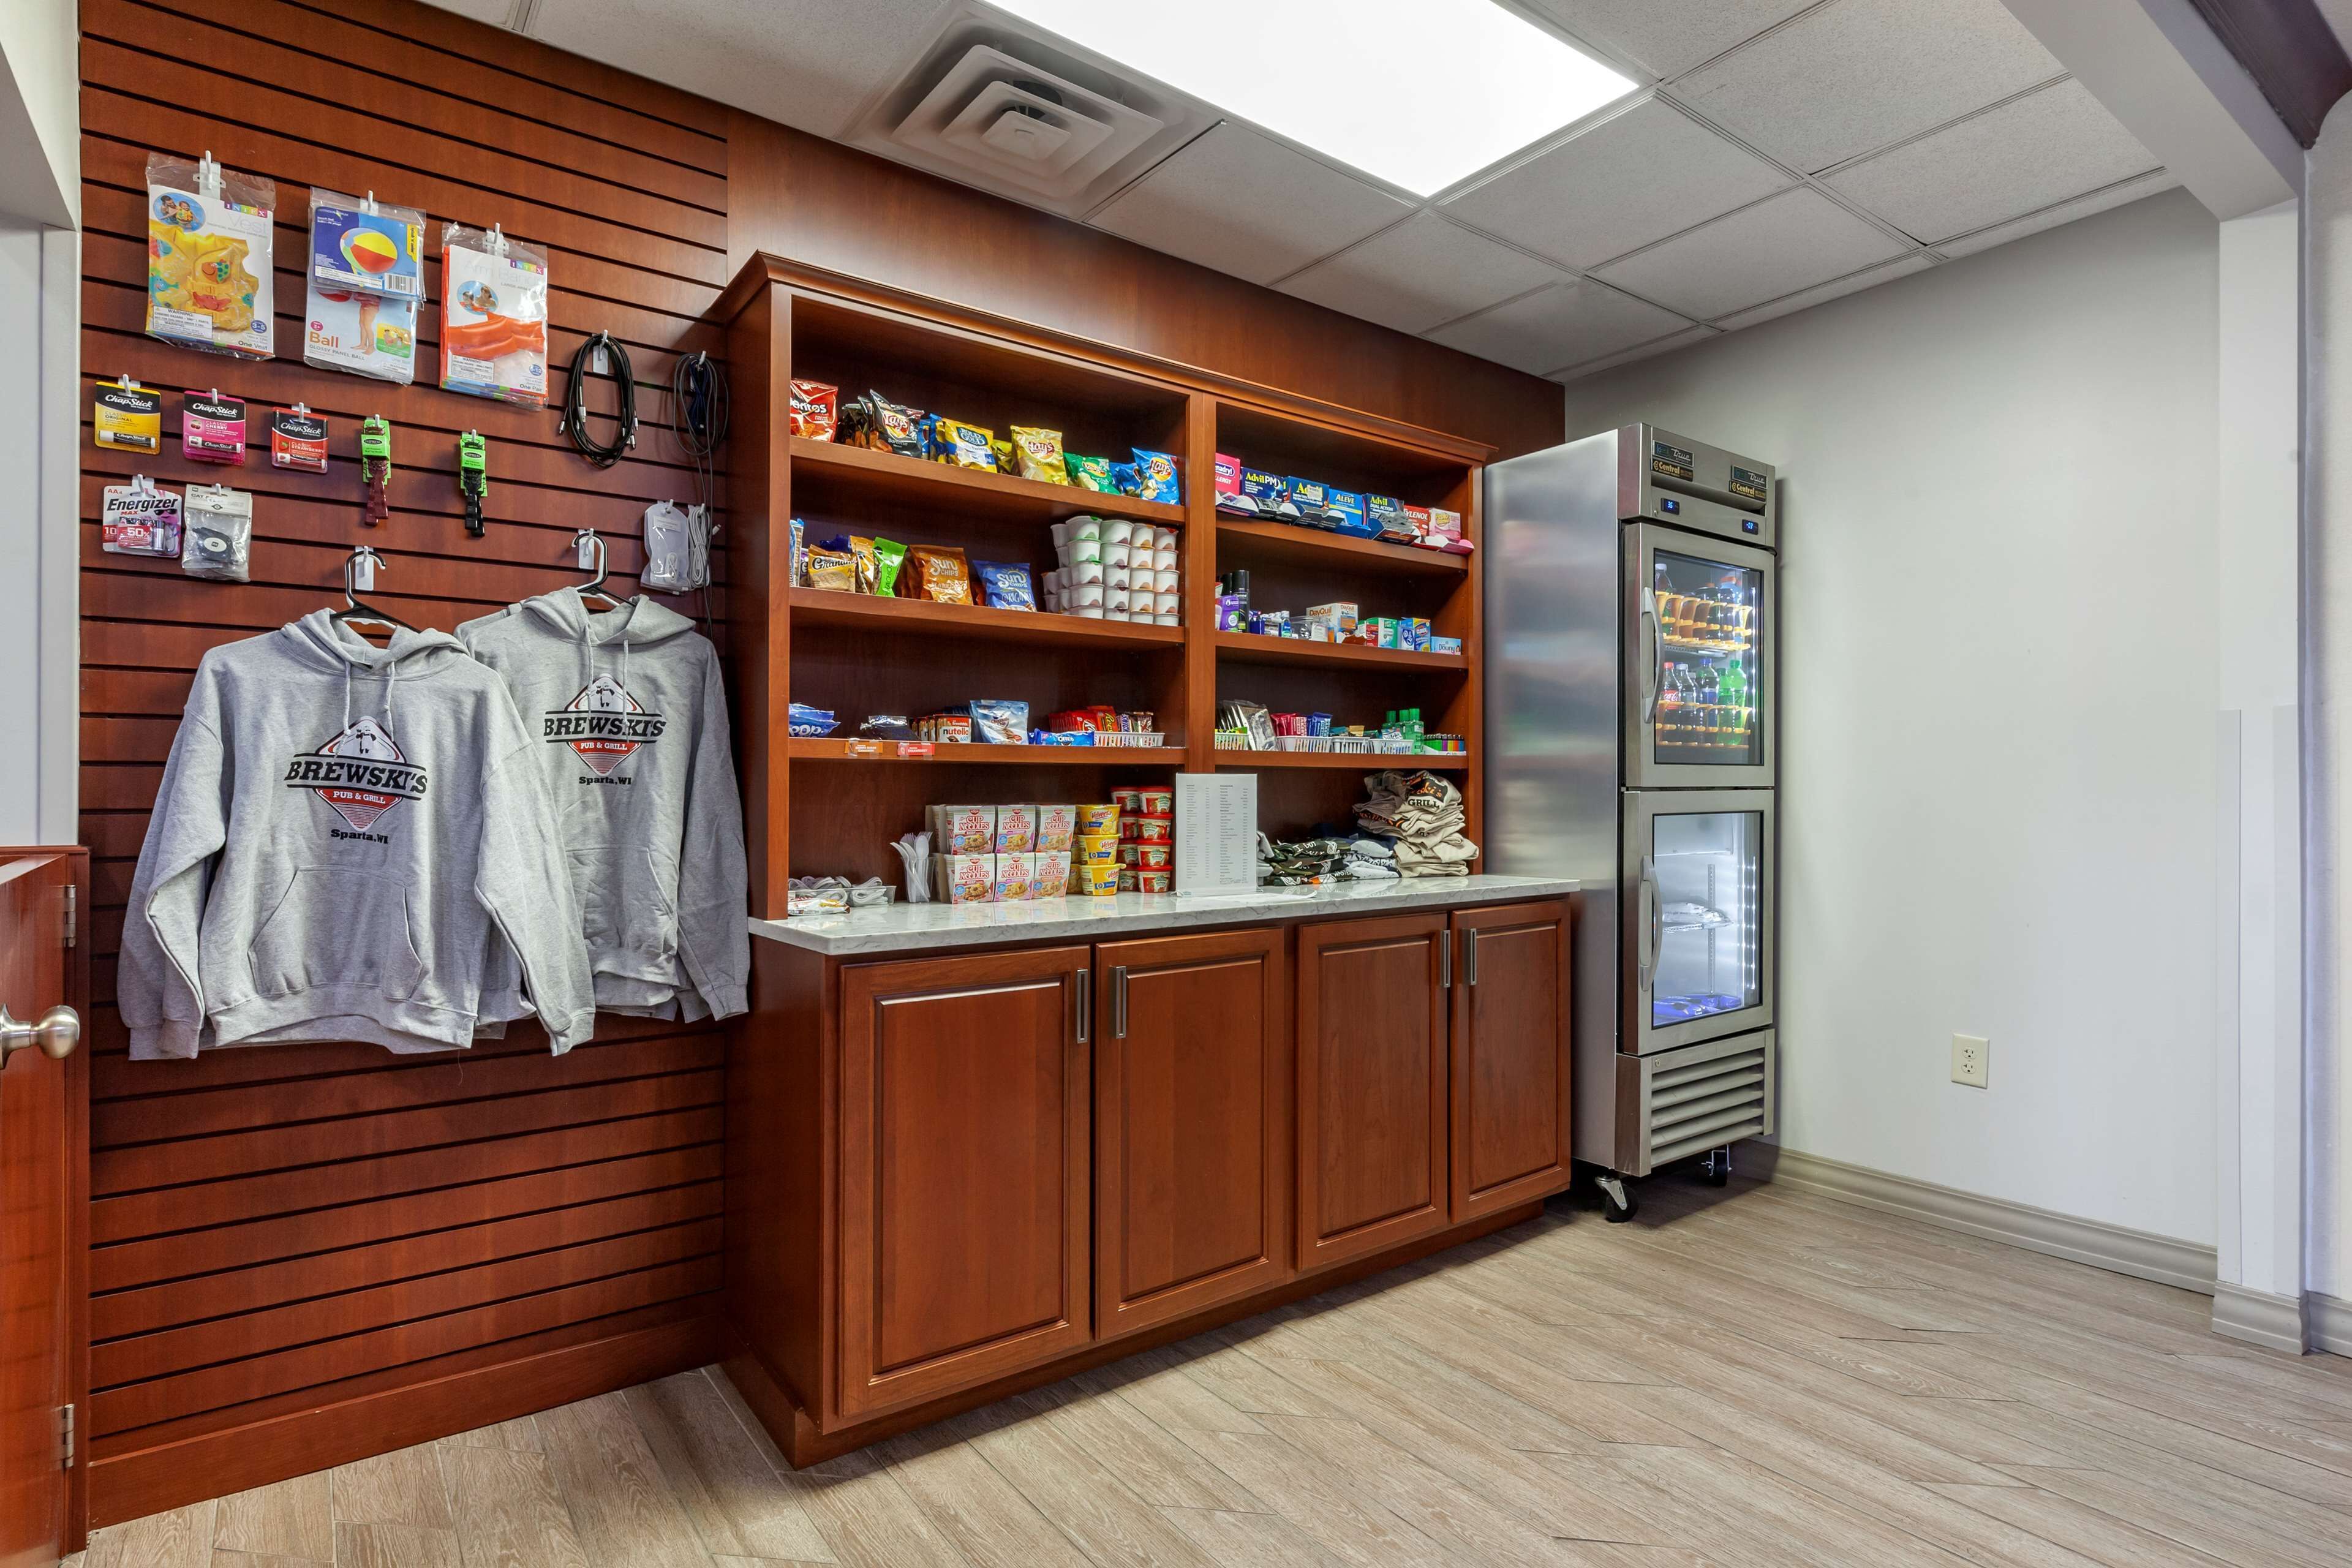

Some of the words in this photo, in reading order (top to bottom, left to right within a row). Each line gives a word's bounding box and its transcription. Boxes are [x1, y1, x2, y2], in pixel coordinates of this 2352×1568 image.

[225, 202, 266, 217] INTEX
[230, 214, 268, 234] Vest
[511, 261, 544, 274] INTEX
[309, 331, 339, 348] Ball
[309, 344, 331, 353] GLOSSY
[105, 394, 153, 408] ChapStick
[790, 397, 827, 413] oritos
[192, 402, 238, 415] ChapStick
[281, 422, 322, 435] ChapStick
[960, 428, 981, 438] ROLD
[960, 432, 986, 445] GOLD
[204, 442, 233, 450] ChapStick
[1028, 441, 1055, 454] Lay's
[1215, 464, 1233, 476] nadryl
[1659, 461, 1680, 475] Central
[1246, 472, 1265, 483] Advil
[1265, 475, 1277, 486] PM
[1736, 483, 1755, 496] Central
[107, 497, 178, 513] Energizer
[1335, 494, 1355, 504] ALEVE
[1370, 496, 1388, 506] Advil
[1403, 508, 1429, 520] TYLENOL
[104, 527, 118, 536] 10
[127, 527, 149, 538] 50%
[812, 557, 856, 570] Grand
[930, 556, 959, 576] Sun
[997, 573, 1027, 588] Sun
[1310, 606, 1332, 617] DayQuil
[1439, 643, 1456, 654] Downy
[544, 716, 667, 737] BREWSKI'S
[943, 726, 969, 736] nutella
[284, 760, 428, 794] BREWSKI'S
[333, 790, 353, 799] PUB
[363, 793, 386, 804] GRILL
[1408, 798, 1439, 808] GRILL
[1090, 810, 1112, 820] Velveeta
[959, 821, 990, 831] NOODLES
[1002, 821, 1030, 830] NOODLES
[1044, 821, 1070, 830] NOODLES
[966, 864, 984, 873] CUP
[1001, 869, 1030, 878] NOODLES
[1038, 868, 1065, 876] NOODLES
[959, 870, 990, 881] NOODLES
